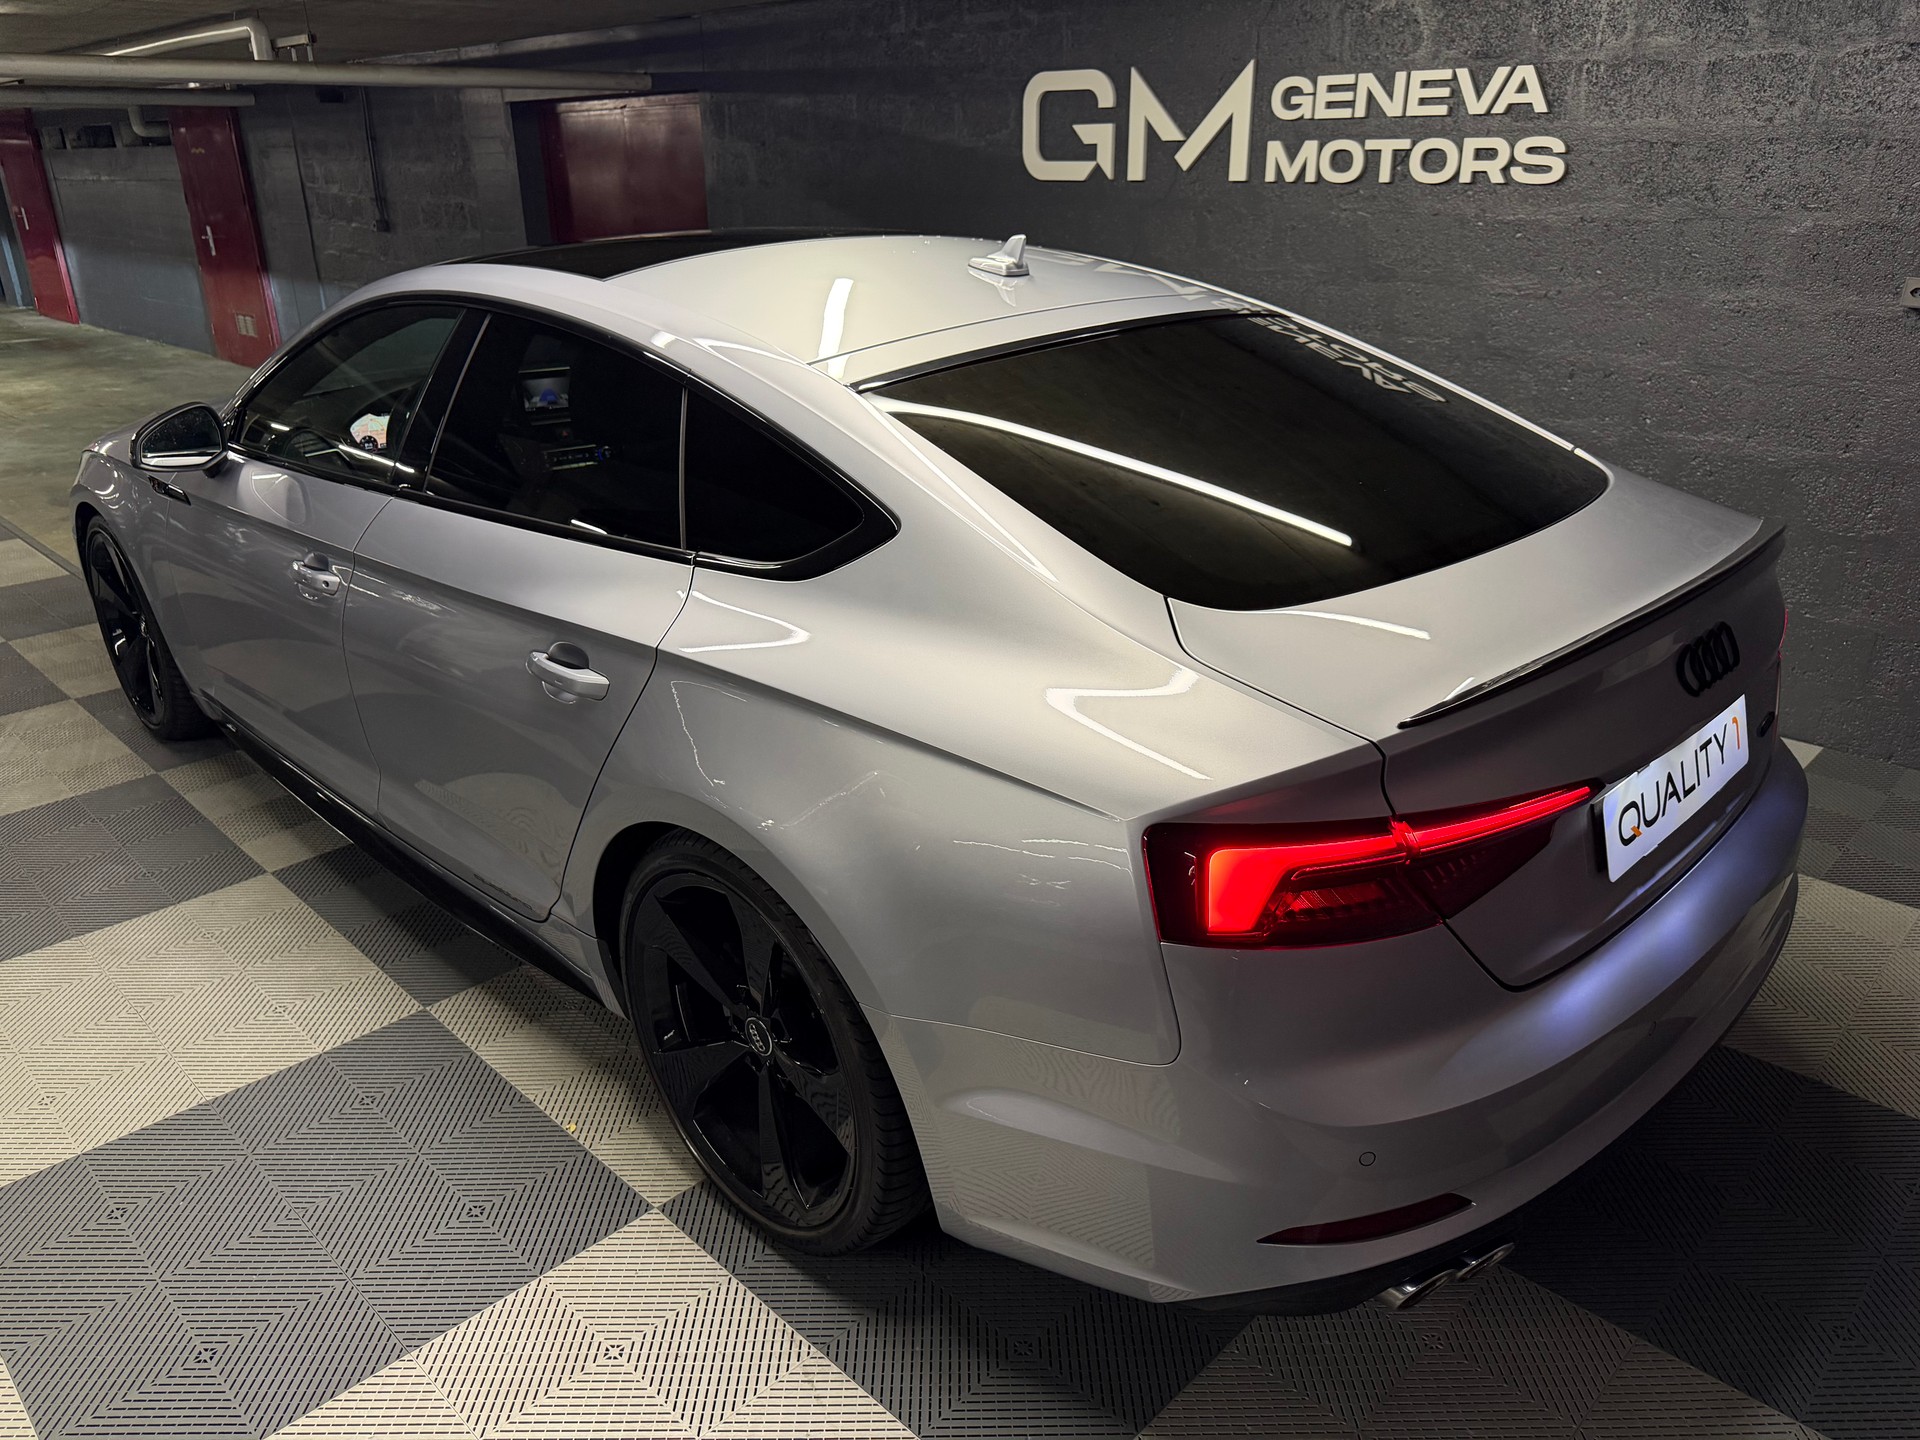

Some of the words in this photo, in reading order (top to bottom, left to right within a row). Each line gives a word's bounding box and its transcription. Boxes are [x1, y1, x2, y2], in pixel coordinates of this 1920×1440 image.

[1271, 65, 1548, 120] GENEVA
[1022, 59, 1255, 182] GM
[1264, 136, 1567, 185] MOTORS
